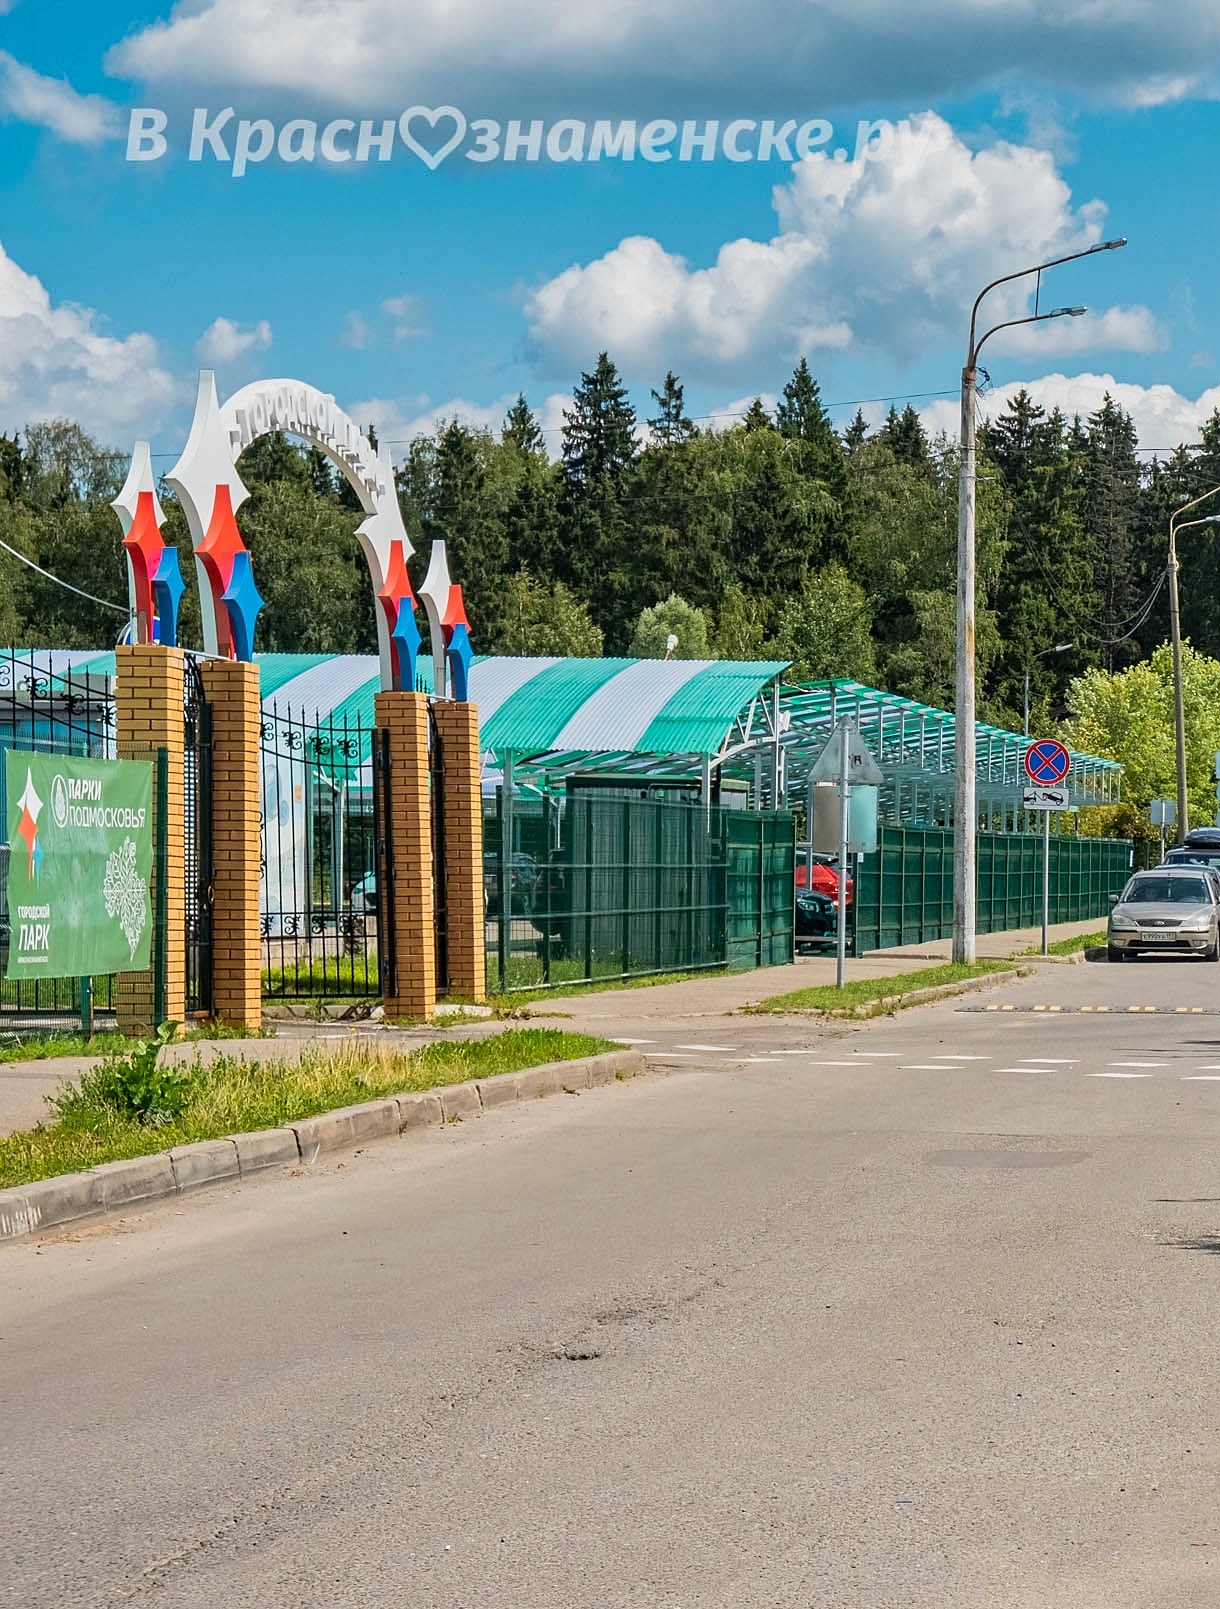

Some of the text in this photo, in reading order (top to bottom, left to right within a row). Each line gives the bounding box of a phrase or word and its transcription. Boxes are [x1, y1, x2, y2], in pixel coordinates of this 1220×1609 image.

[68, 778, 101, 801] ПАРКИ
[69, 806, 146, 829] ПОДМОСКОВЬЯ
[18, 923, 50, 951] ПАРК
